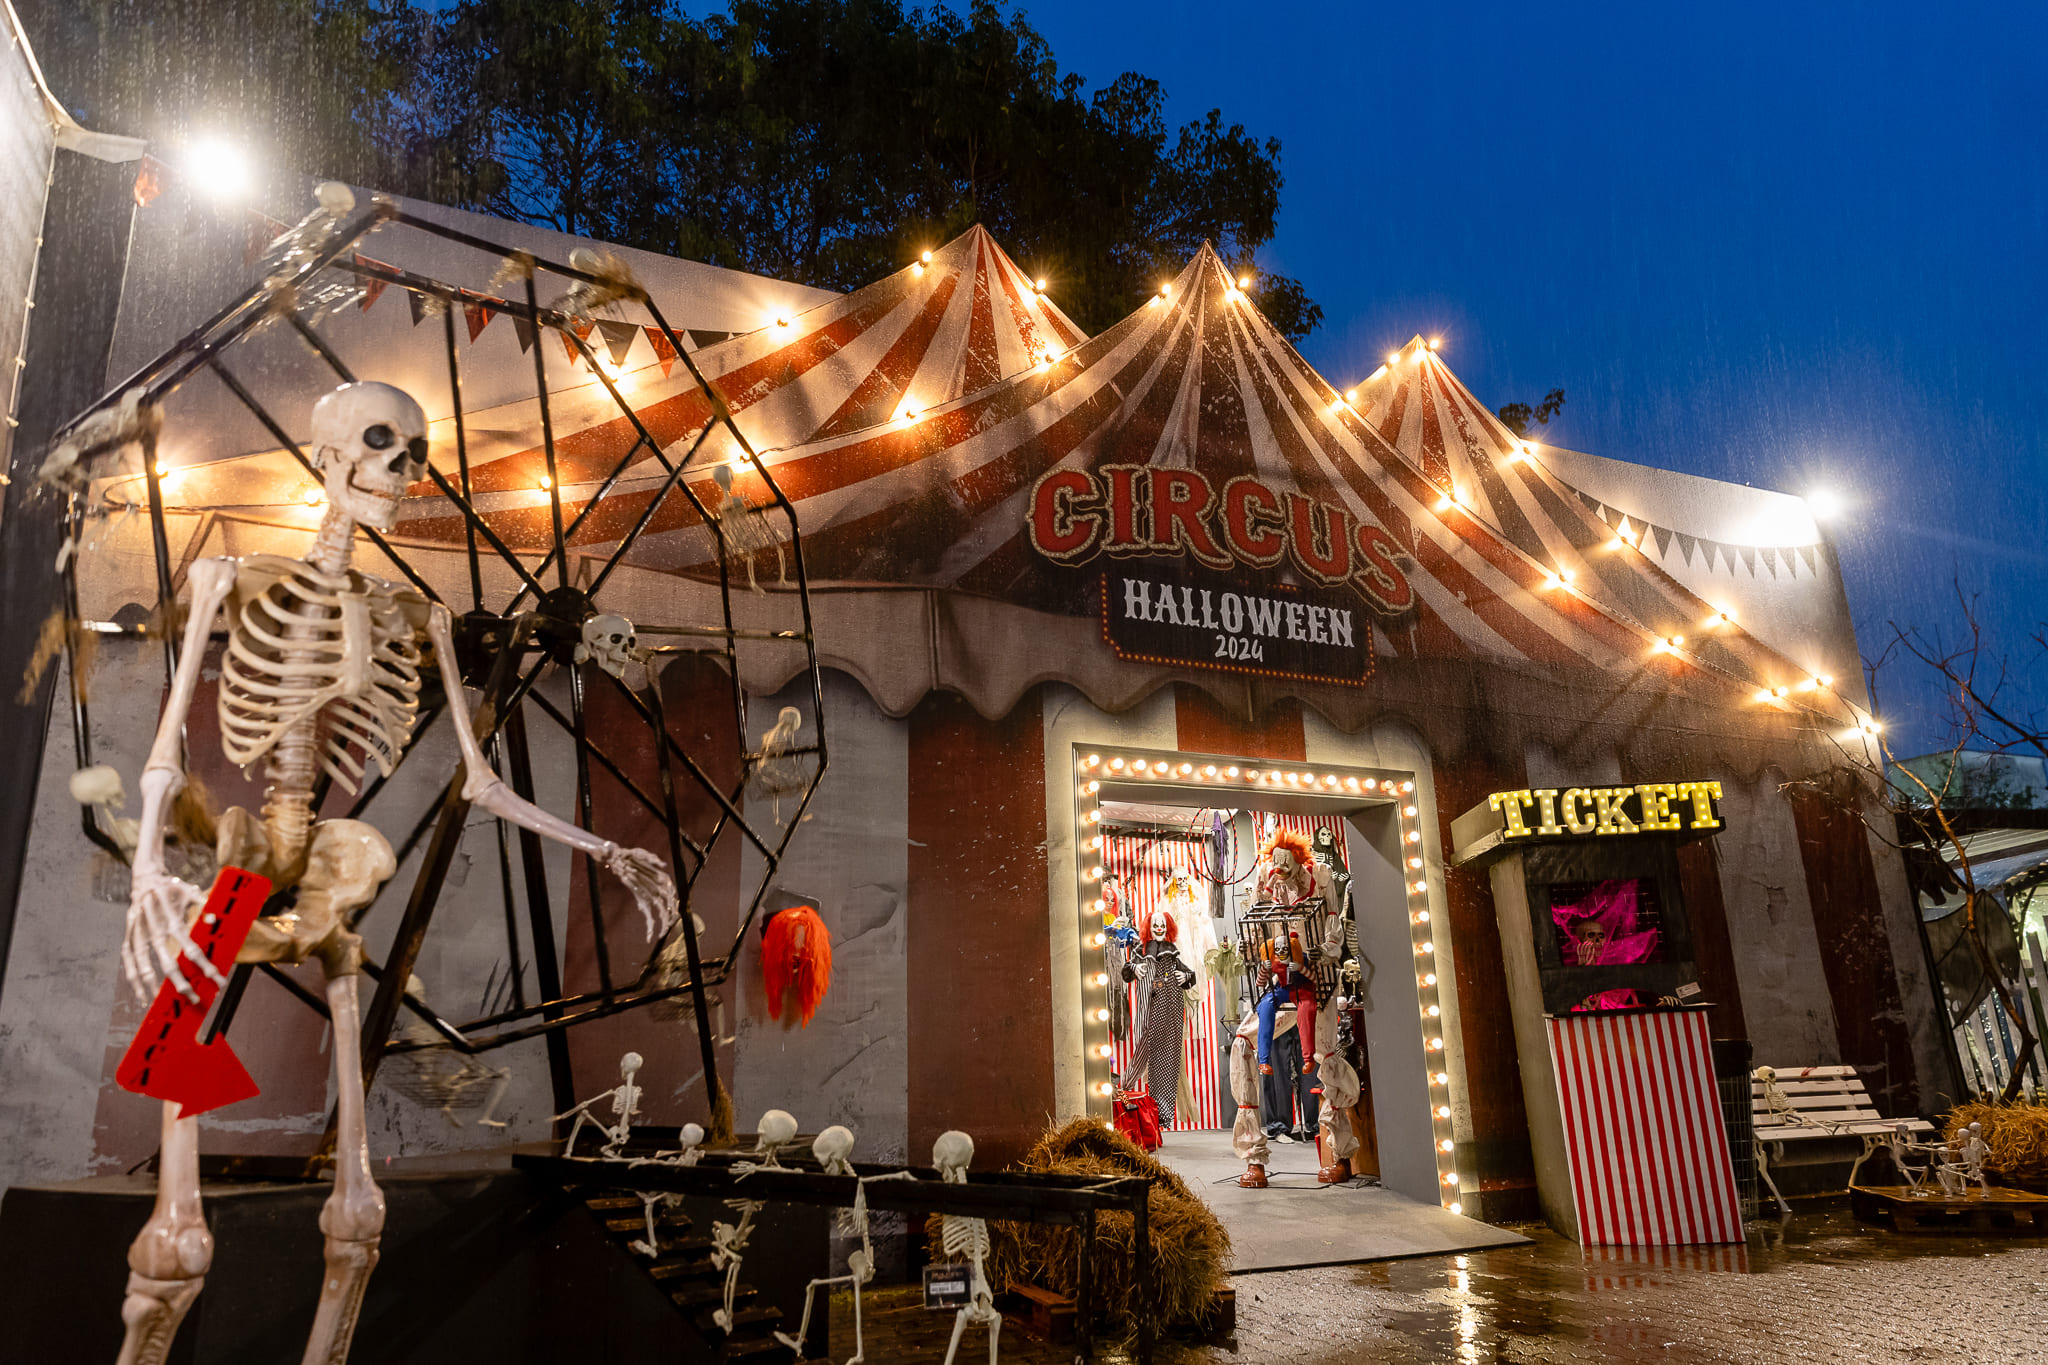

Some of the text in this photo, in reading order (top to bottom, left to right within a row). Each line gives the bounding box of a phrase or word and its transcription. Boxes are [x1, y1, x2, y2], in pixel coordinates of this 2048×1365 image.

[1028, 463, 1416, 616] CIRCUS
[1123, 578, 1354, 648] HALLOWEEN
[1214, 634, 1263, 662] 2024
[1489, 781, 1723, 838] TICKET
